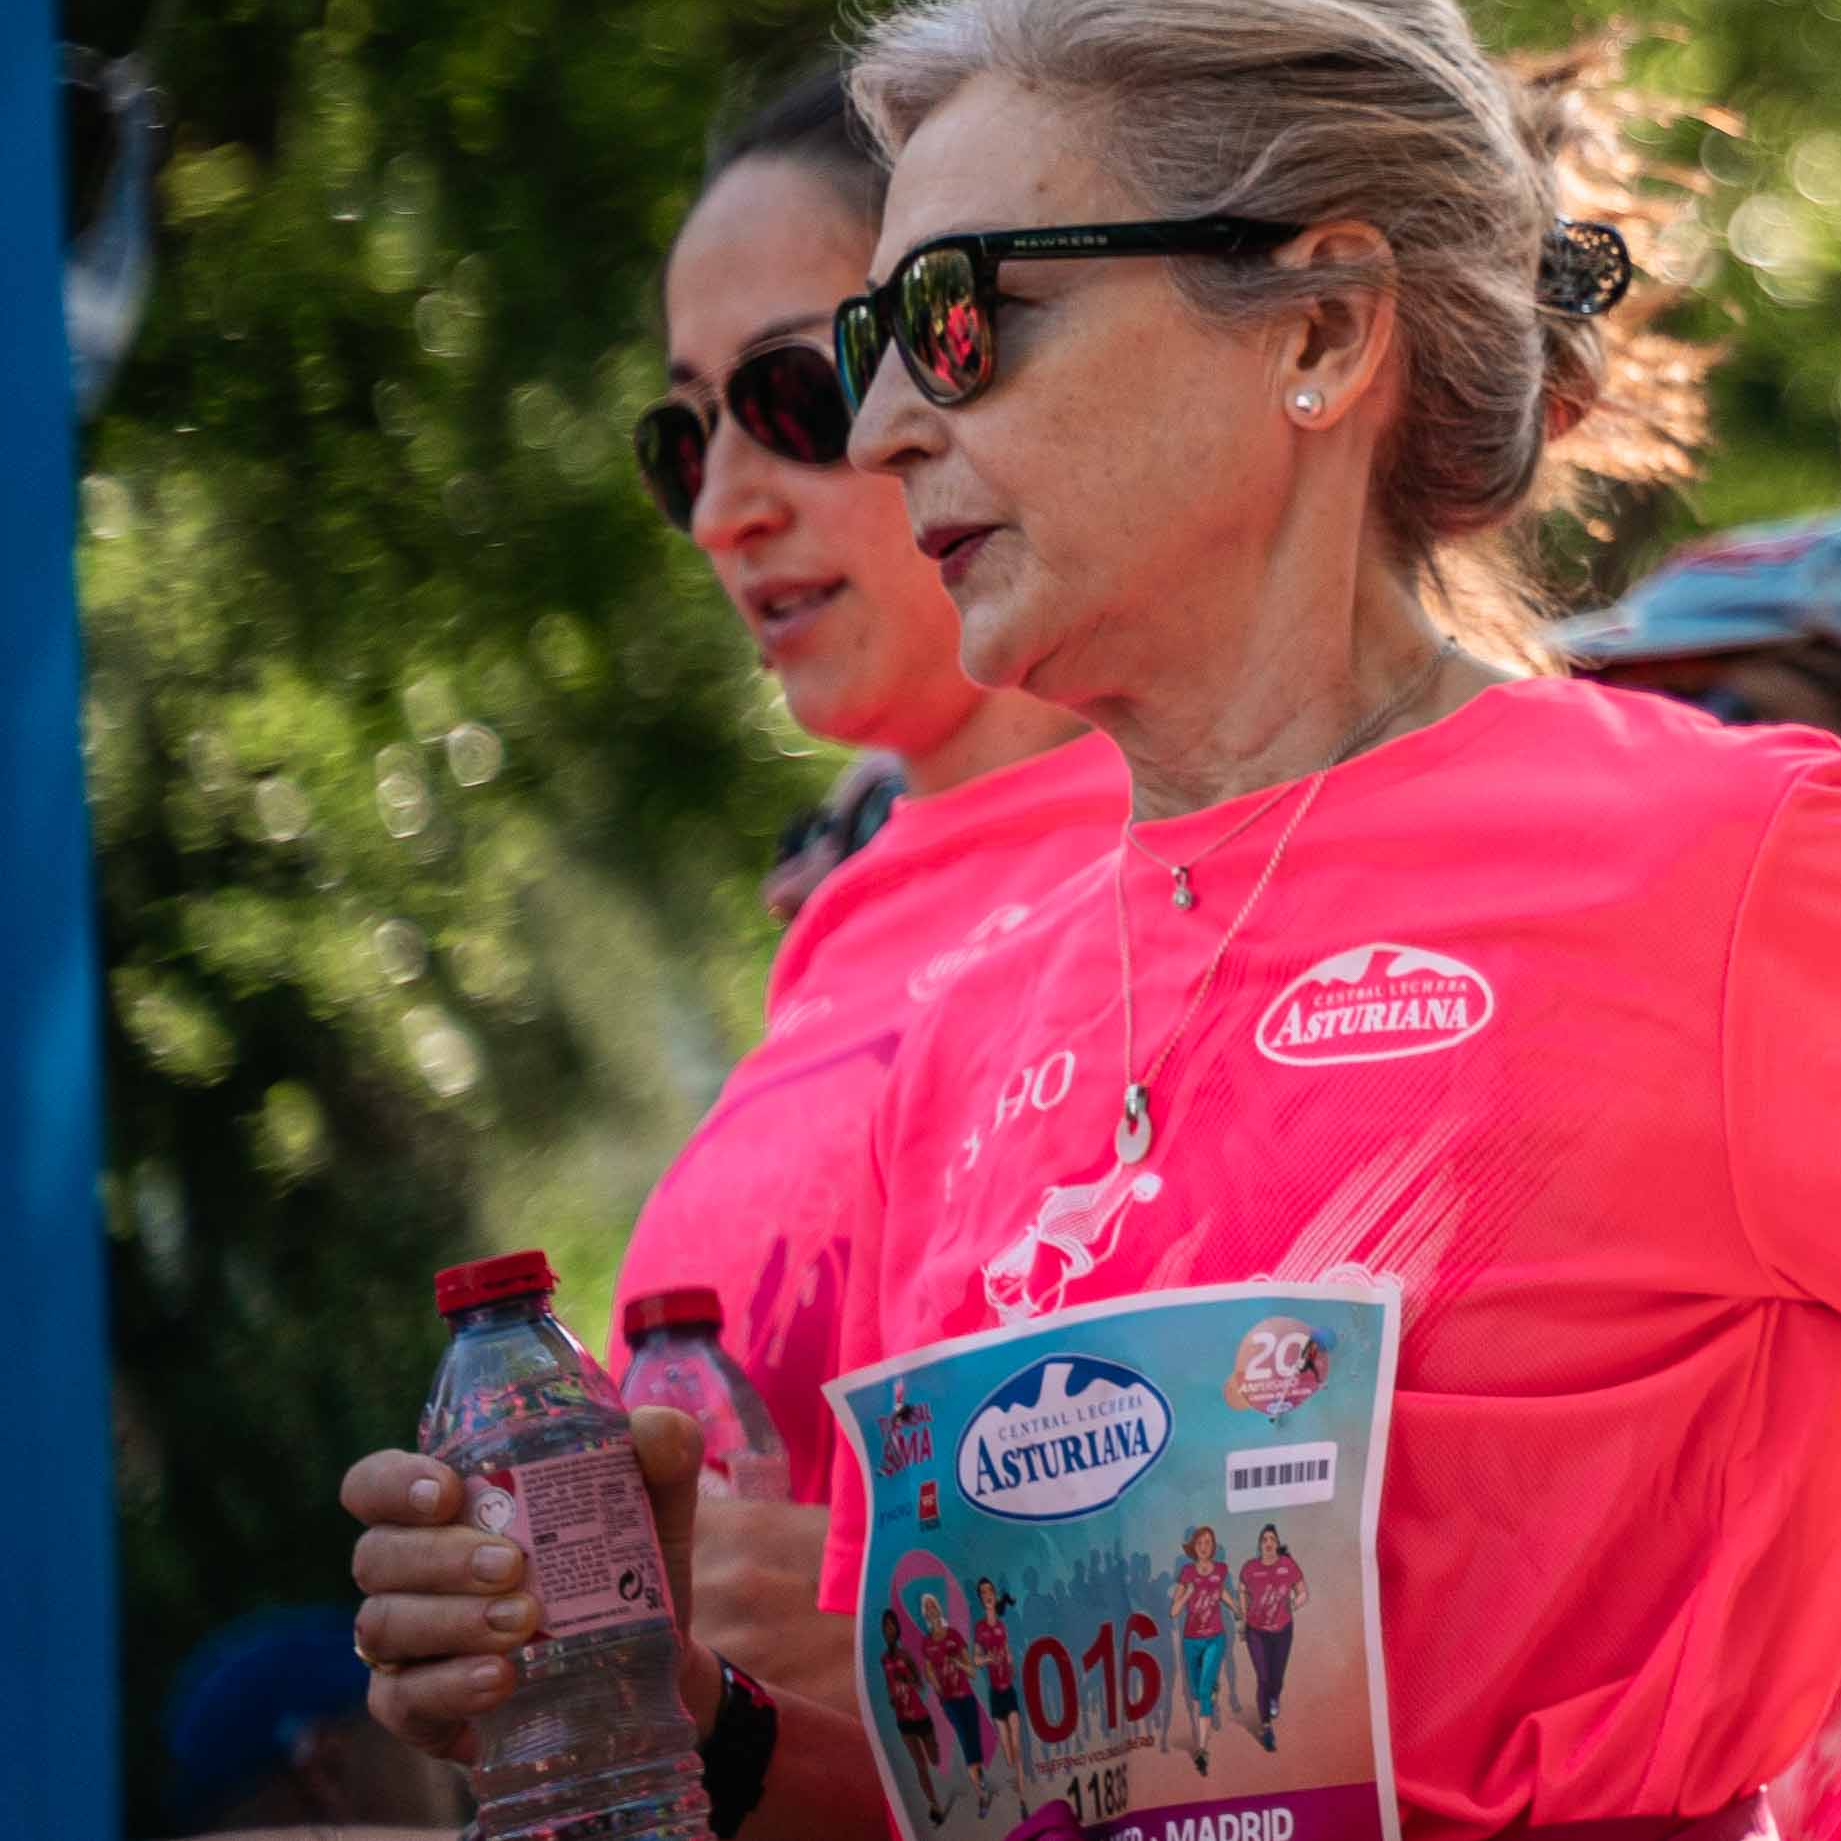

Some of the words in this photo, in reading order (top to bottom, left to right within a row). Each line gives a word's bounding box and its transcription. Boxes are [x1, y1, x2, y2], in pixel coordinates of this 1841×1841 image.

[1314, 985, 1382, 1007] CENTRAL
[1389, 978, 1469, 996] LECHERA
[1268, 997, 1469, 1048] ASTURIANA
[1245, 1332, 1310, 1380] 20
[998, 1413, 1071, 1440] CENTRAL
[1078, 1394, 1144, 1423] LECHERA
[975, 1417, 1152, 1495] ASTURIANA
[1022, 1613, 1161, 1743] 016
